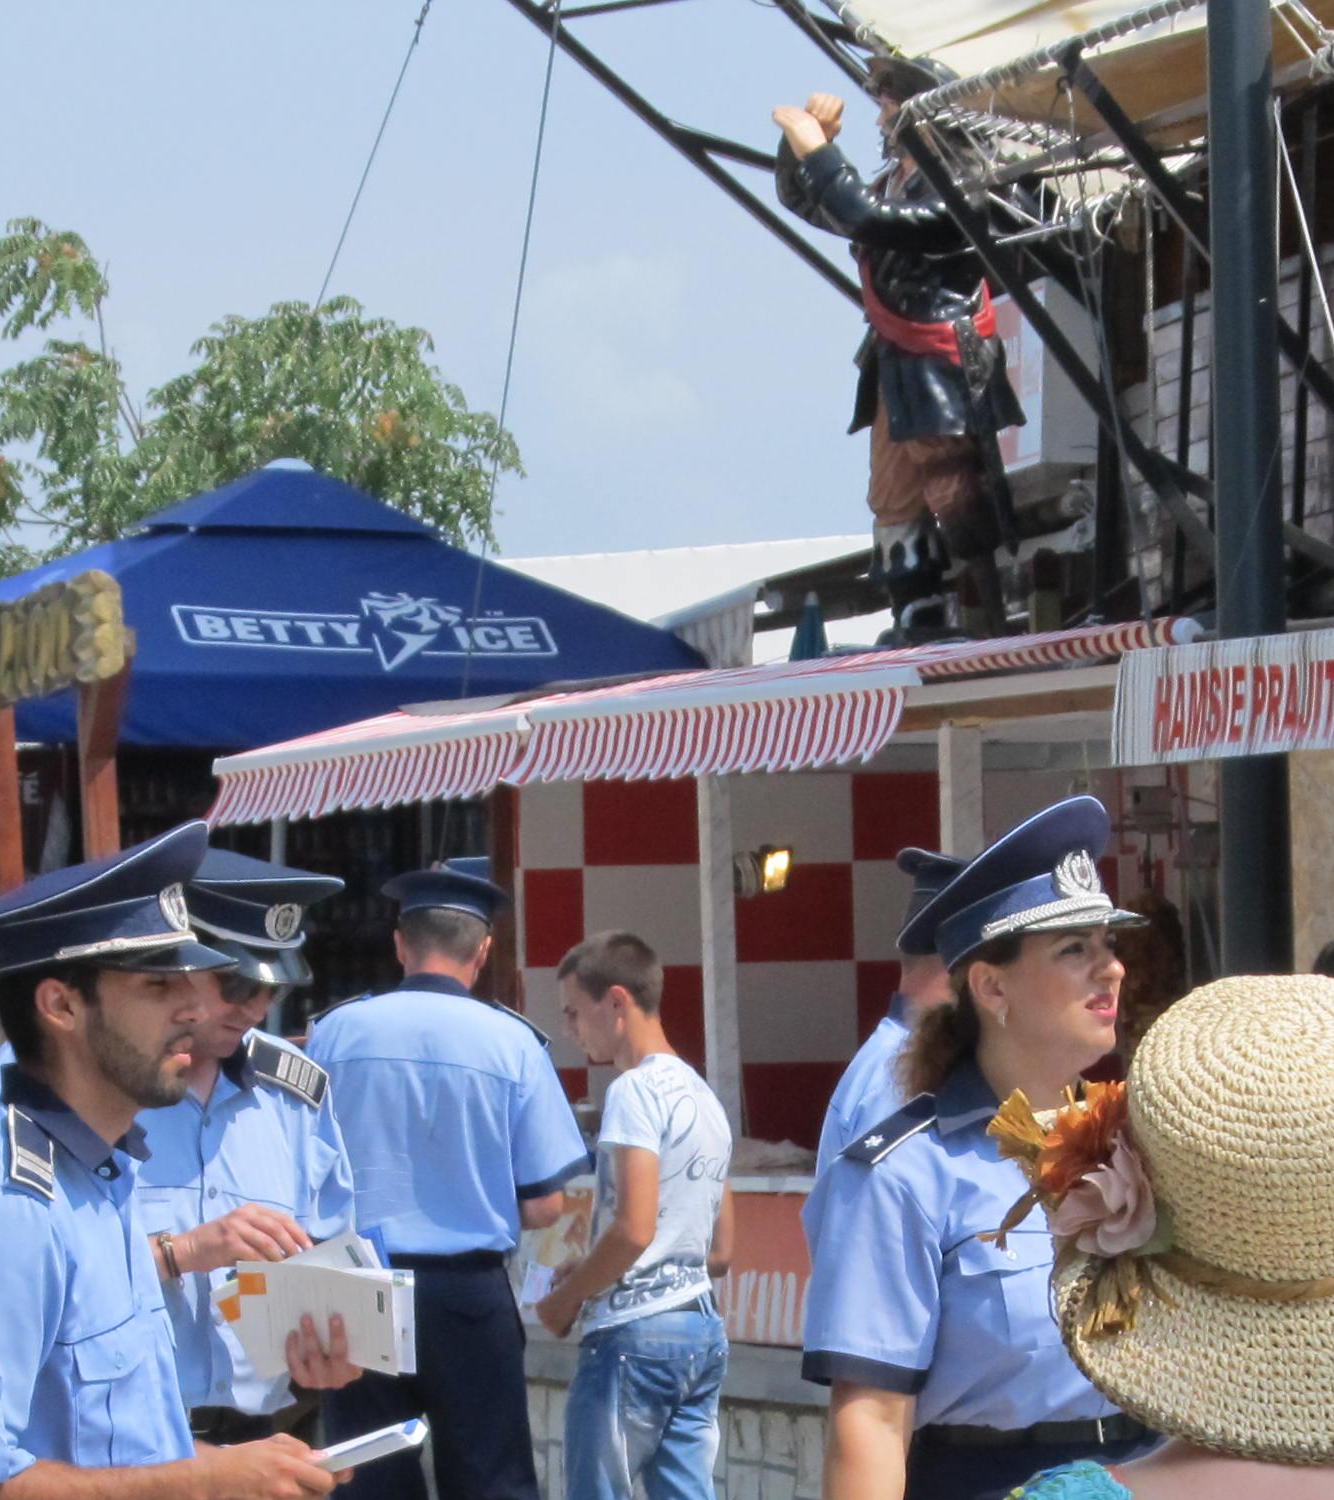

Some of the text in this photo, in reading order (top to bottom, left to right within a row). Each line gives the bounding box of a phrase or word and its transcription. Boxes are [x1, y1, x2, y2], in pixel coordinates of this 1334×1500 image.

[194, 614, 541, 650] BETTY ICE
[1152, 664, 1246, 753] HAMSIE
